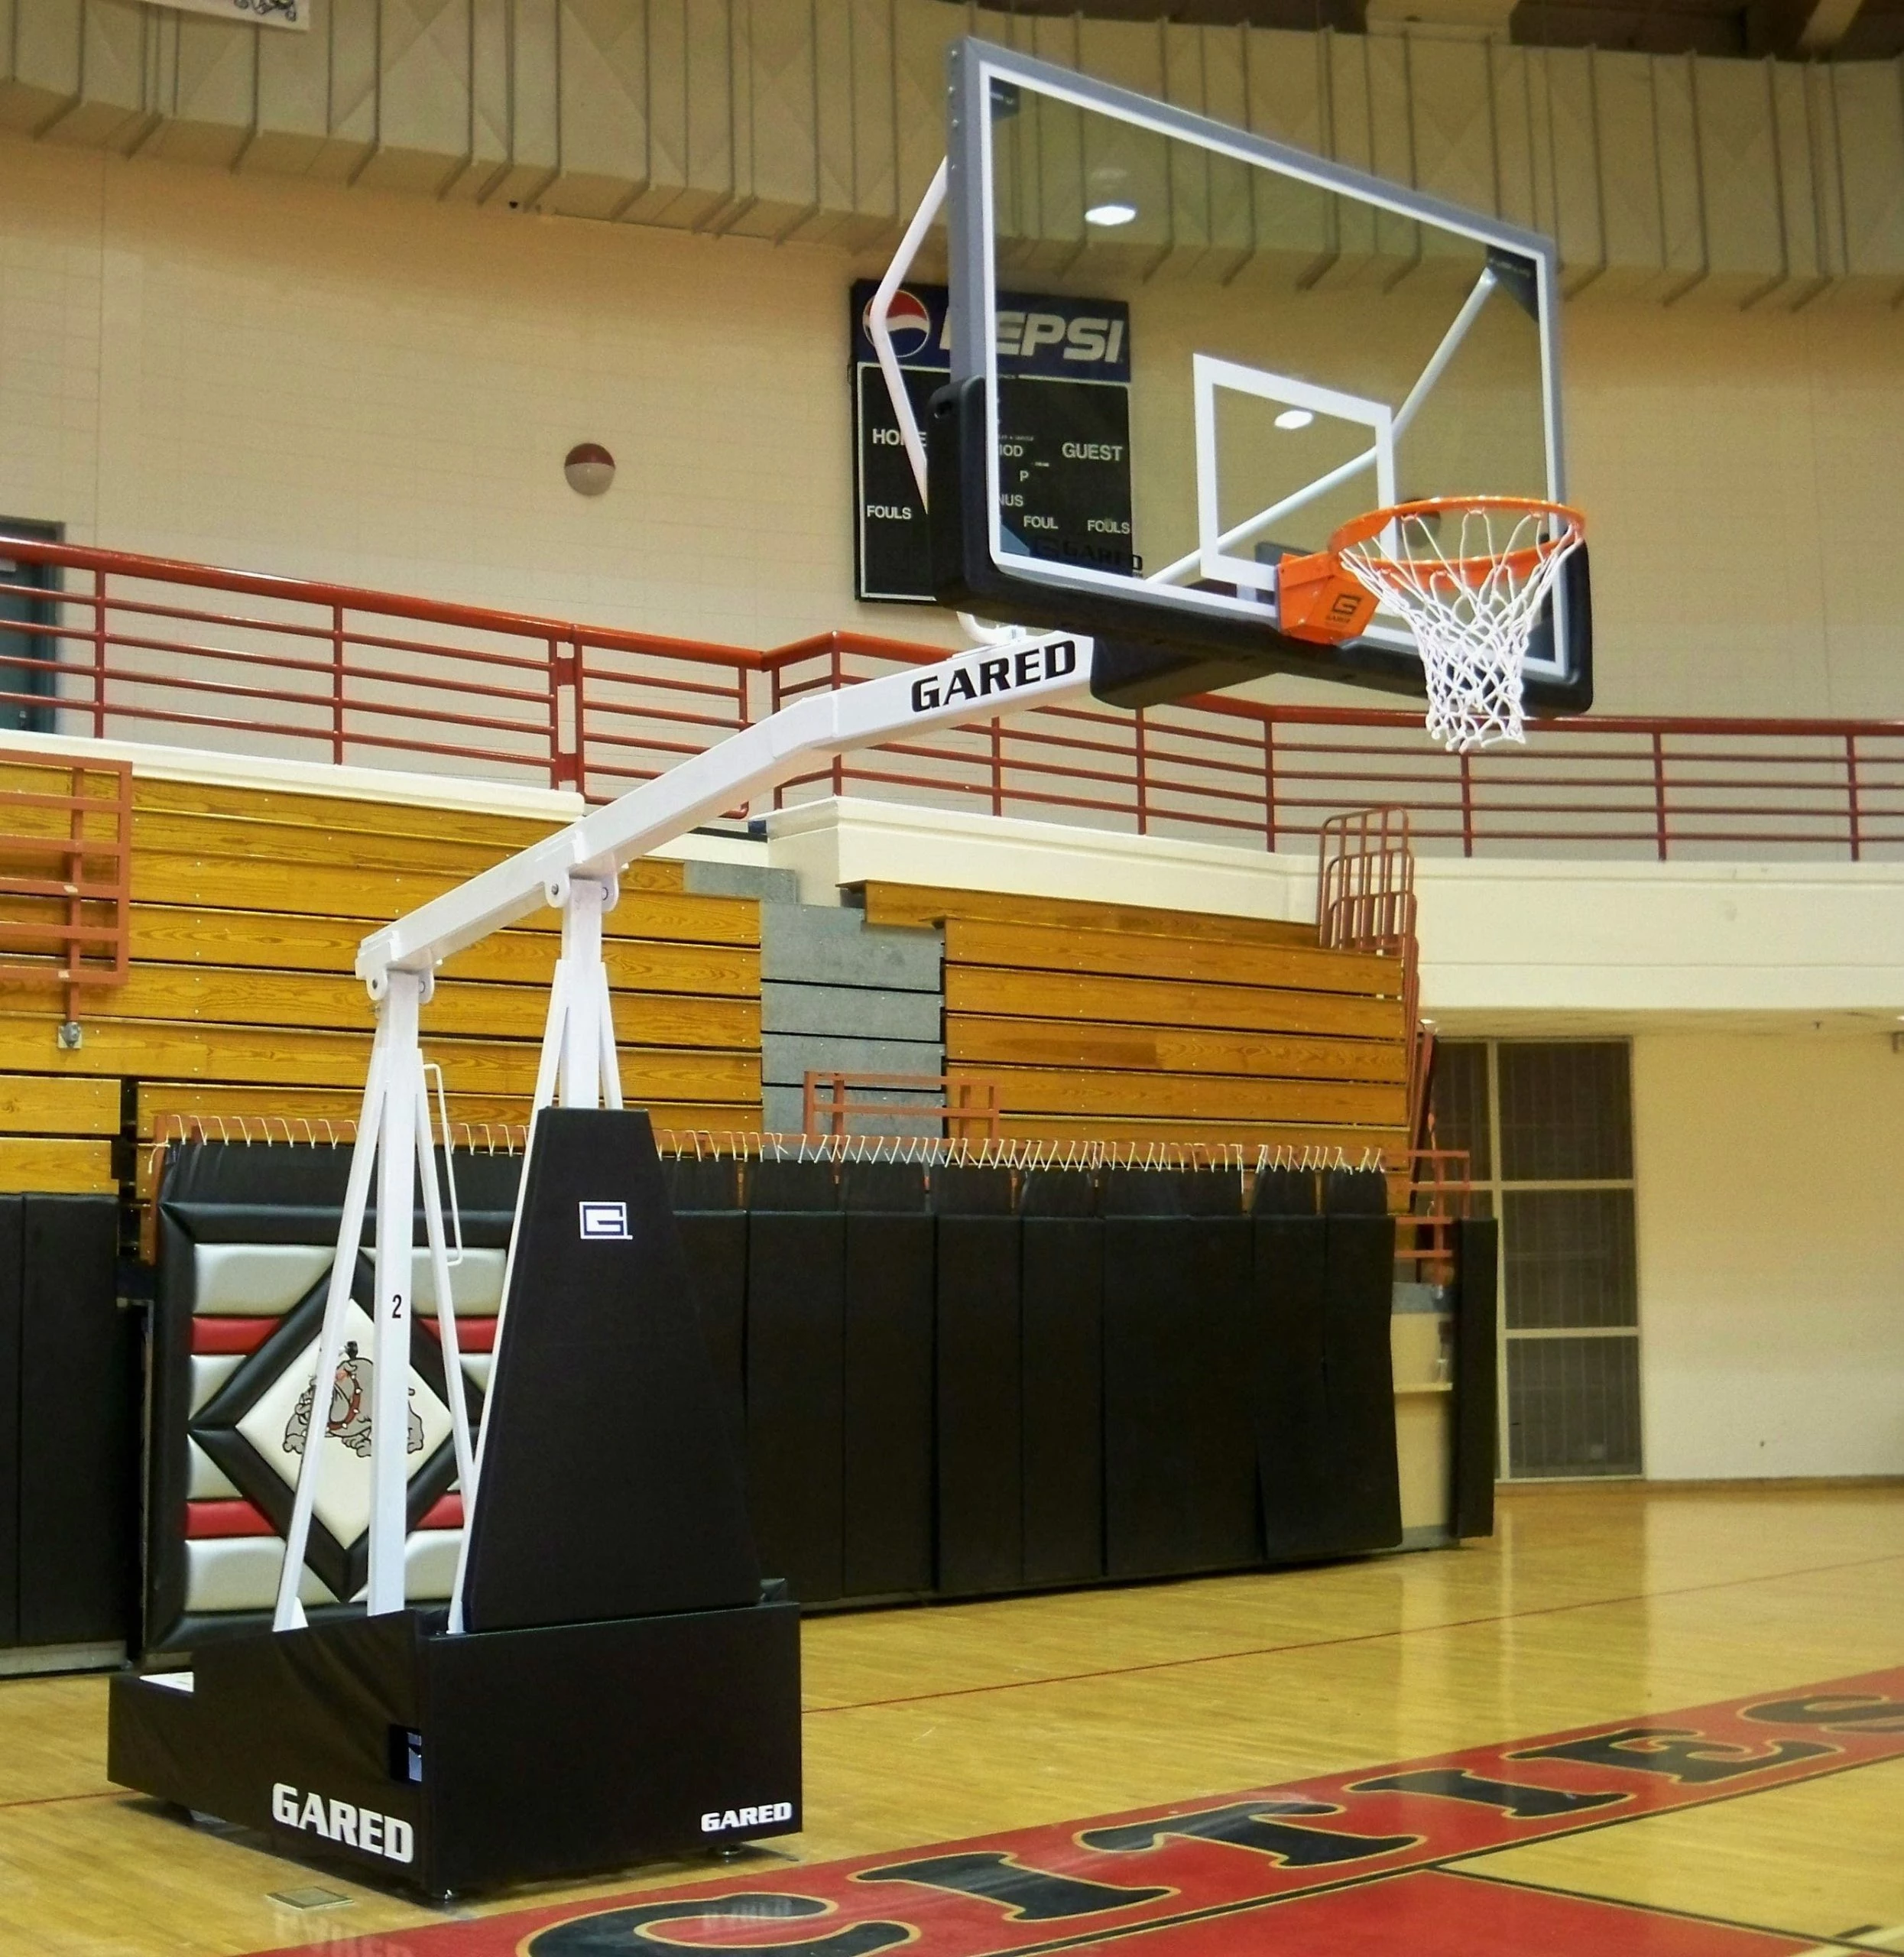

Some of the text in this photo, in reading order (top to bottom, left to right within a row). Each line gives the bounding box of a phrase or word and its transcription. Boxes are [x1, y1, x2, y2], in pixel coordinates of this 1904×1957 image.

[939, 307, 1124, 362] EPSI
[873, 428, 926, 446] HOE
[1062, 442, 1123, 461] GUEST
[1020, 470, 1029, 482] P
[867, 505, 912, 520] FOULS
[1023, 514, 1059, 530] FOUL
[1087, 519, 1130, 534] FOULS
[911, 640, 1076, 712] GARED
[391, 1294, 402, 1319] 2
[272, 1782, 414, 1864] GARED
[701, 1802, 792, 1832] GARED
